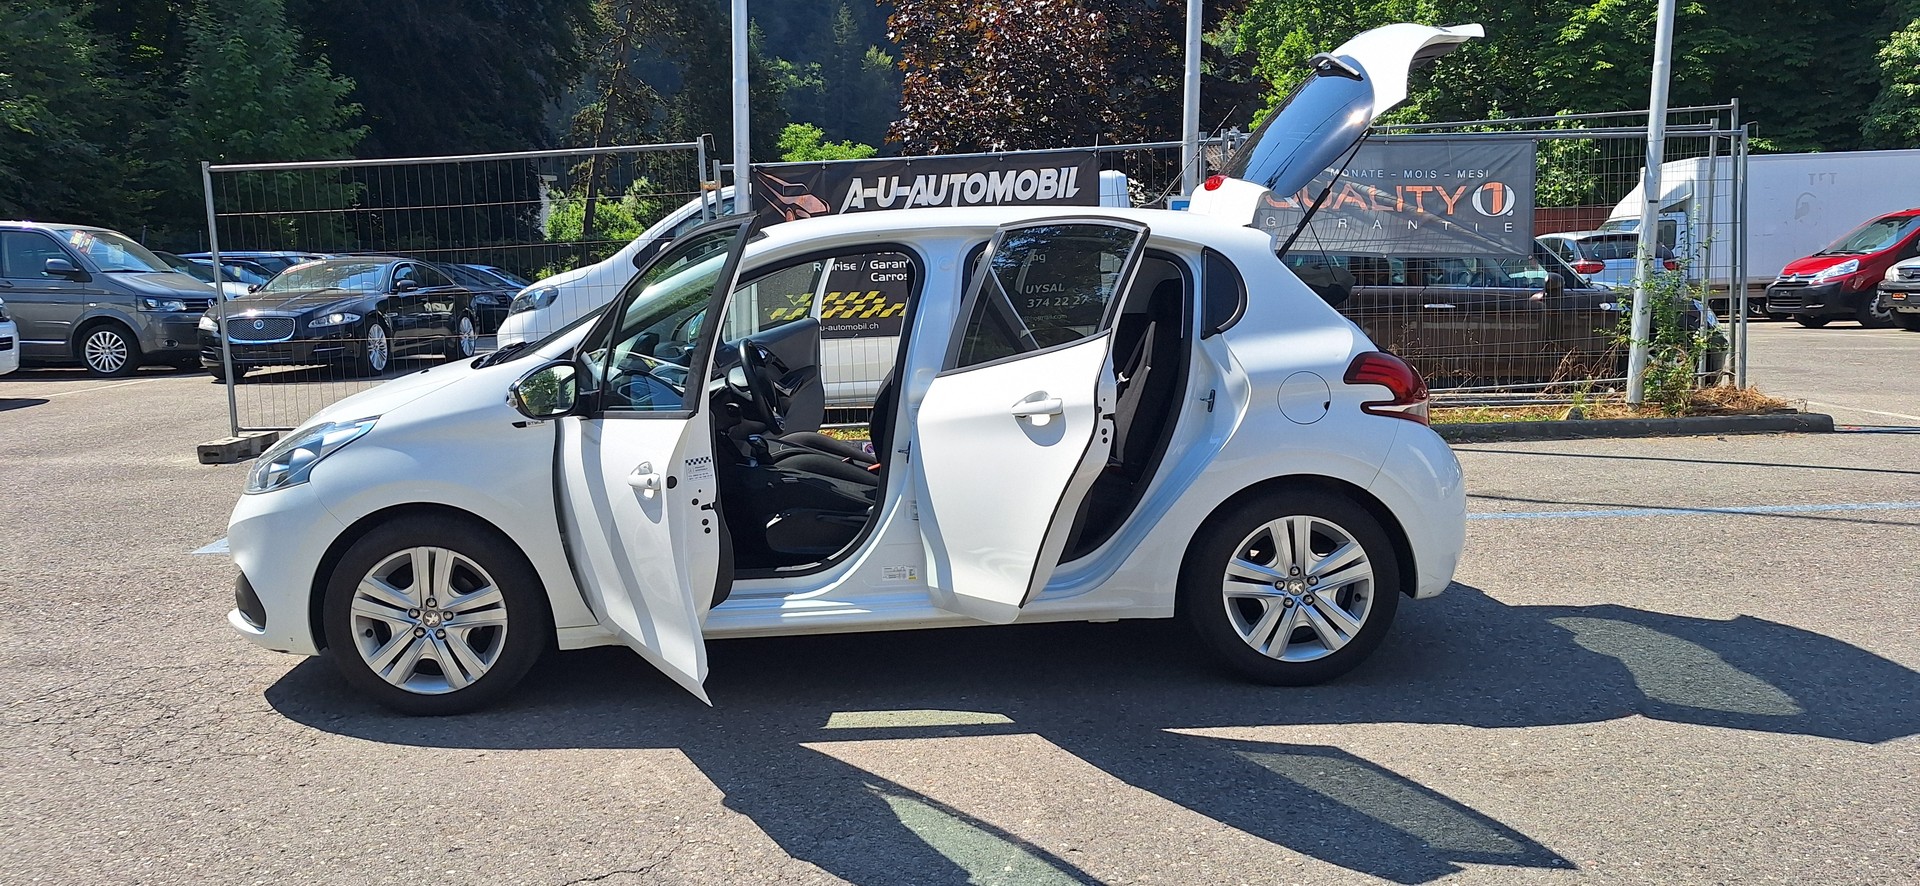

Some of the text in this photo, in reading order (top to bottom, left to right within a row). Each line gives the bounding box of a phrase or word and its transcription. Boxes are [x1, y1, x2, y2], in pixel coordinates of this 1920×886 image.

[1330, 169, 1384, 178] MONATE
[1403, 170, 1437, 179] MOIS
[1457, 170, 1489, 178] MESI
[839, 167, 1080, 214] A-U-AUTOMOBIL
[1265, 216, 1513, 232] GRANTIE
[813, 261, 857, 272] Rrise
[869, 258, 910, 270] Garan
[1025, 283, 1065, 294] UYSAL
[1027, 298, 1050, 308] 374
[1054, 297, 1069, 306] 22
